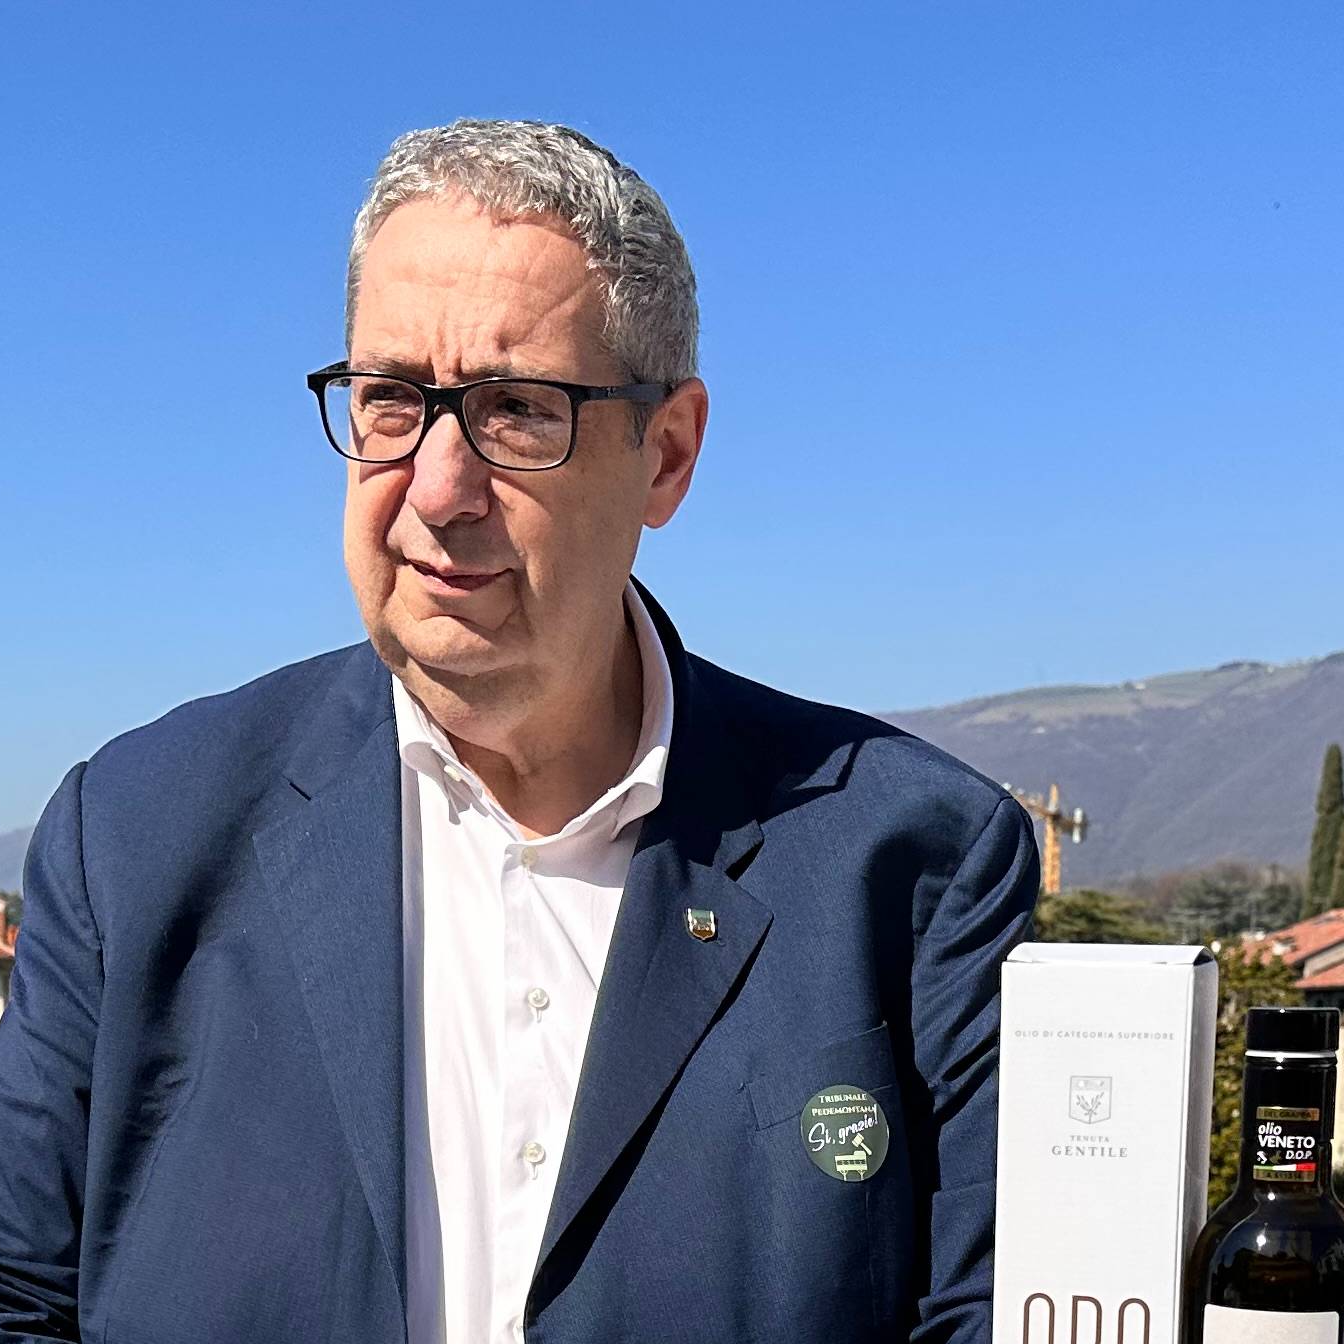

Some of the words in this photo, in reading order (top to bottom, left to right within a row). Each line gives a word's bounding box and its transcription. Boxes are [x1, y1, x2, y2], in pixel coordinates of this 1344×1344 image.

[1015, 1030, 1039, 1038] OLIO
[1043, 1030, 1053, 1038] DI
[1057, 1030, 1114, 1039] CATEGORIA
[1118, 1032, 1174, 1040] SUPERIORE
[818, 1094, 867, 1103] TRIBUNALE
[839, 1104, 878, 1145] grazie!
[1258, 1122, 1282, 1135] olio
[1258, 1134, 1316, 1149] VENETO
[1052, 1145, 1128, 1158] GENTILE
[1285, 1150, 1314, 1160] D.O.P.
